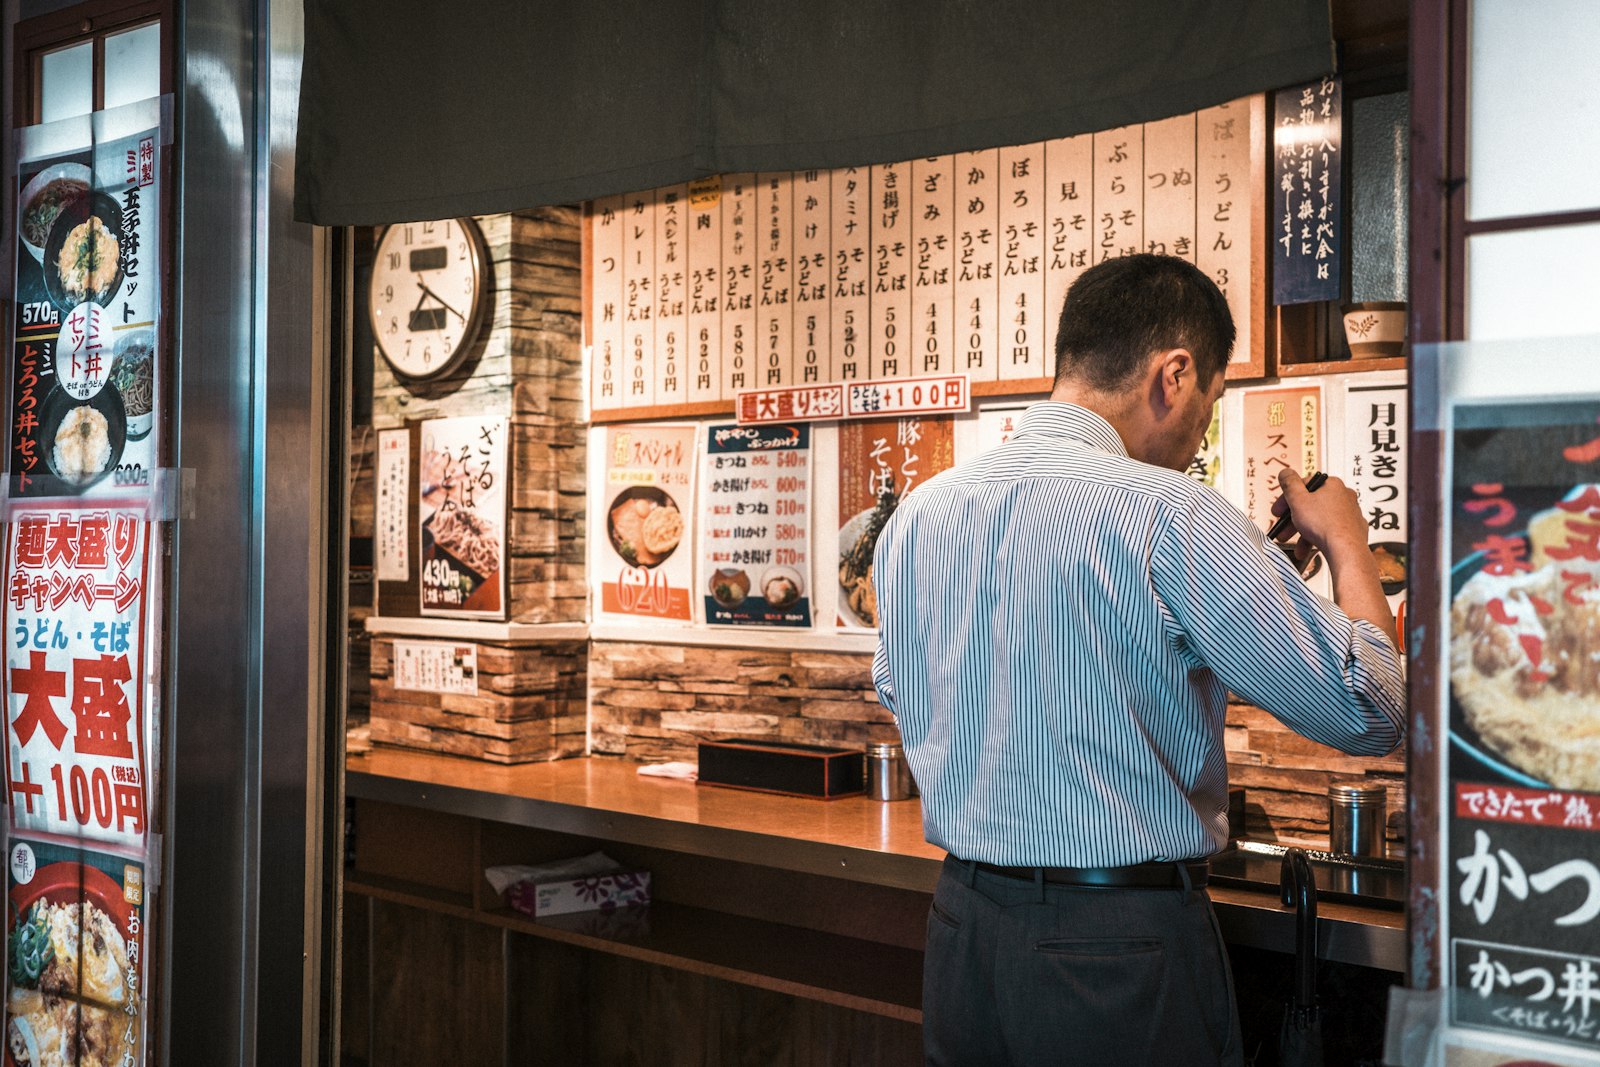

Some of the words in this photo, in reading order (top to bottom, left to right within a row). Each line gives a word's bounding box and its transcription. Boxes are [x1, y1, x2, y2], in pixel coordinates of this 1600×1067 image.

[141, 143, 153, 182] 特製
[967, 150, 985, 215] かめ
[1108, 126, 1128, 194] ぷら
[923, 157, 941, 221] ざみ
[404, 227, 413, 245] 11
[633, 201, 644, 264] カレー
[959, 231, 974, 282] うどん
[977, 229, 992, 280] そば
[1004, 225, 1020, 276] うどん
[1022, 222, 1039, 274] そば
[1051, 217, 1068, 270] うどん
[1069, 214, 1087, 267] そば
[388, 252, 401, 270] 10
[761, 260, 773, 306] うどん
[775, 258, 788, 304] そば
[797, 256, 810, 301] うどん
[812, 253, 826, 300] そば
[835, 250, 848, 298] うどん
[851, 248, 865, 296] そば
[875, 245, 888, 293] うどん
[891, 243, 906, 291] そば
[916, 238, 931, 287] うどん
[933, 235, 948, 285] そば
[386, 285, 394, 303] 9
[627, 280, 637, 320] うどん
[640, 278, 650, 320] そば
[659, 274, 670, 318] うどん
[672, 273, 683, 316] そば
[692, 271, 702, 314] うどん
[705, 268, 716, 312] そば
[726, 267, 737, 311] うどん
[739, 264, 752, 310] そば
[22, 301, 58, 324] 570円
[967, 297, 983, 368] 440円
[1013, 293, 1029, 364] 440円
[40, 342, 54, 376] ミニ
[69, 313, 85, 378] セット
[85, 309, 103, 381] ミニ丼
[405, 339, 412, 357] 7
[423, 345, 431, 363] 6
[698, 328, 710, 389] 620円
[732, 325, 745, 388] 580円
[768, 319, 781, 385] 570円
[804, 316, 818, 382] 510円
[883, 307, 897, 376] 500円
[924, 303, 939, 372] 440円
[633, 335, 644, 395] 690円
[665, 332, 677, 392] 620円
[852, 386, 880, 400] うどん
[15, 344, 39, 493] とろろ丼セット
[459, 445, 478, 508] そば
[479, 423, 500, 490] ざる
[715, 456, 746, 469] きつね
[869, 437, 892, 496] そば
[1368, 402, 1400, 530] 月見きつね
[712, 477, 750, 492] かき揚げ
[736, 502, 768, 515] きつね
[15, 514, 138, 568] 麺大盛り
[734, 526, 767, 538] 山かけ
[423, 559, 460, 588] 430円
[732, 549, 771, 564] かき揚げ
[10, 571, 140, 612] キャンペーン
[15, 618, 131, 652] うどん・そば
[11, 651, 134, 759] 大盛
[1456, 829, 1600, 926] かつ
[1469, 950, 1600, 1017] かつ丼
